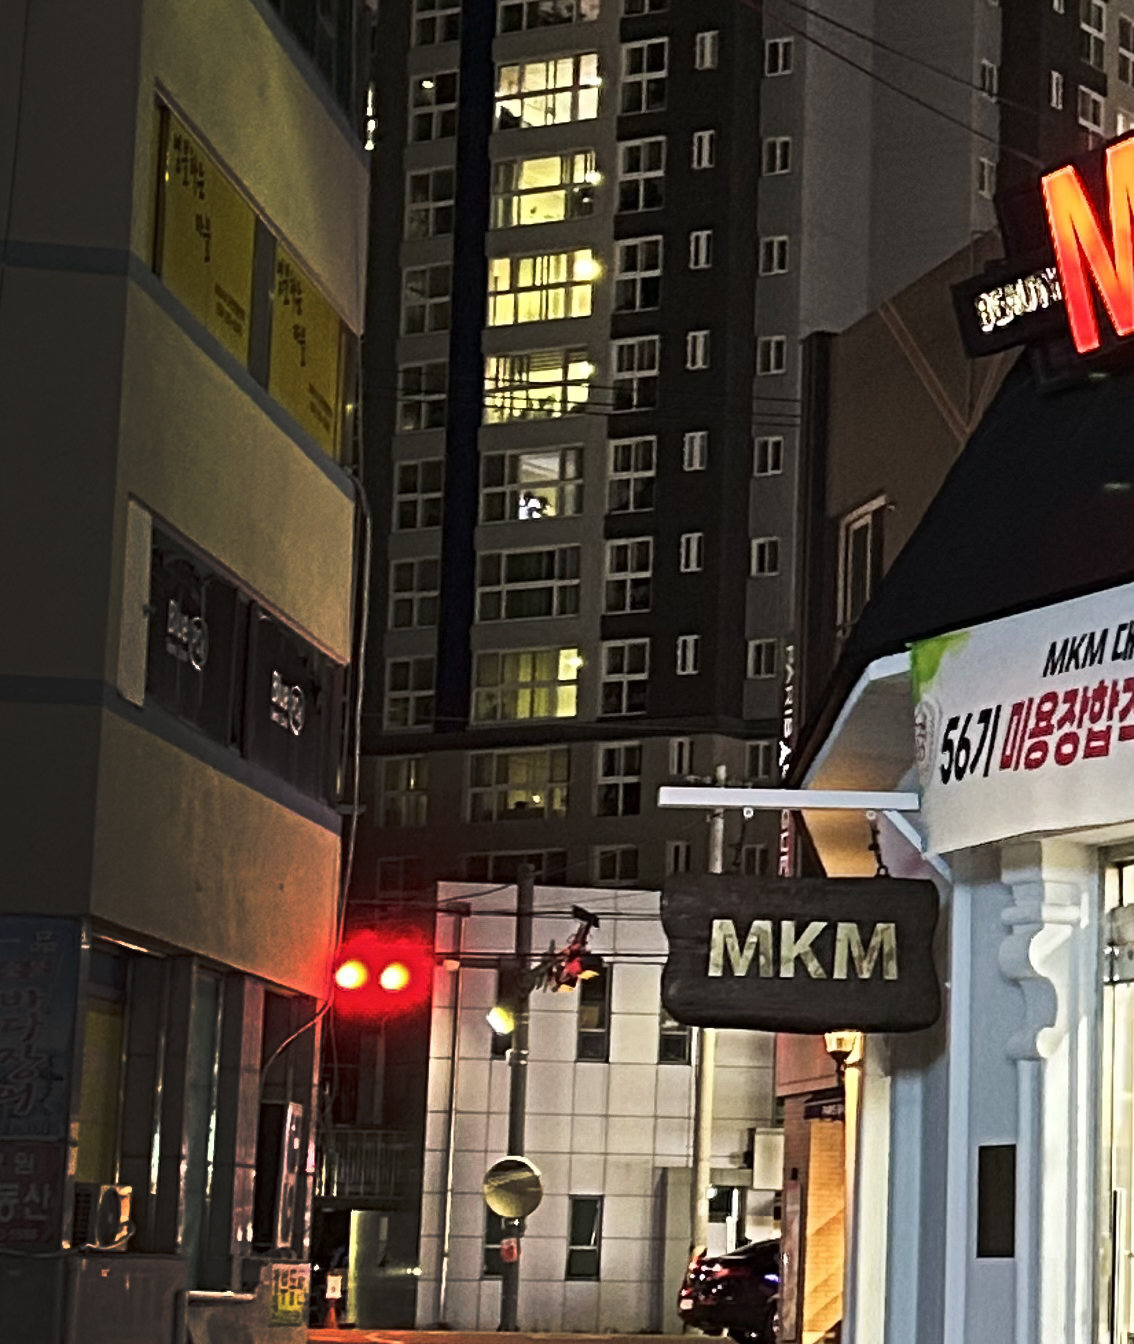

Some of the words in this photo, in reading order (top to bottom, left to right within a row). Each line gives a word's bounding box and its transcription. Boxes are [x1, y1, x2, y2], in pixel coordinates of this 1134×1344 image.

[1042, 626, 1110, 679] MKM
[940, 705, 1001, 785] 56기
[708, 918, 899, 981] MKM
